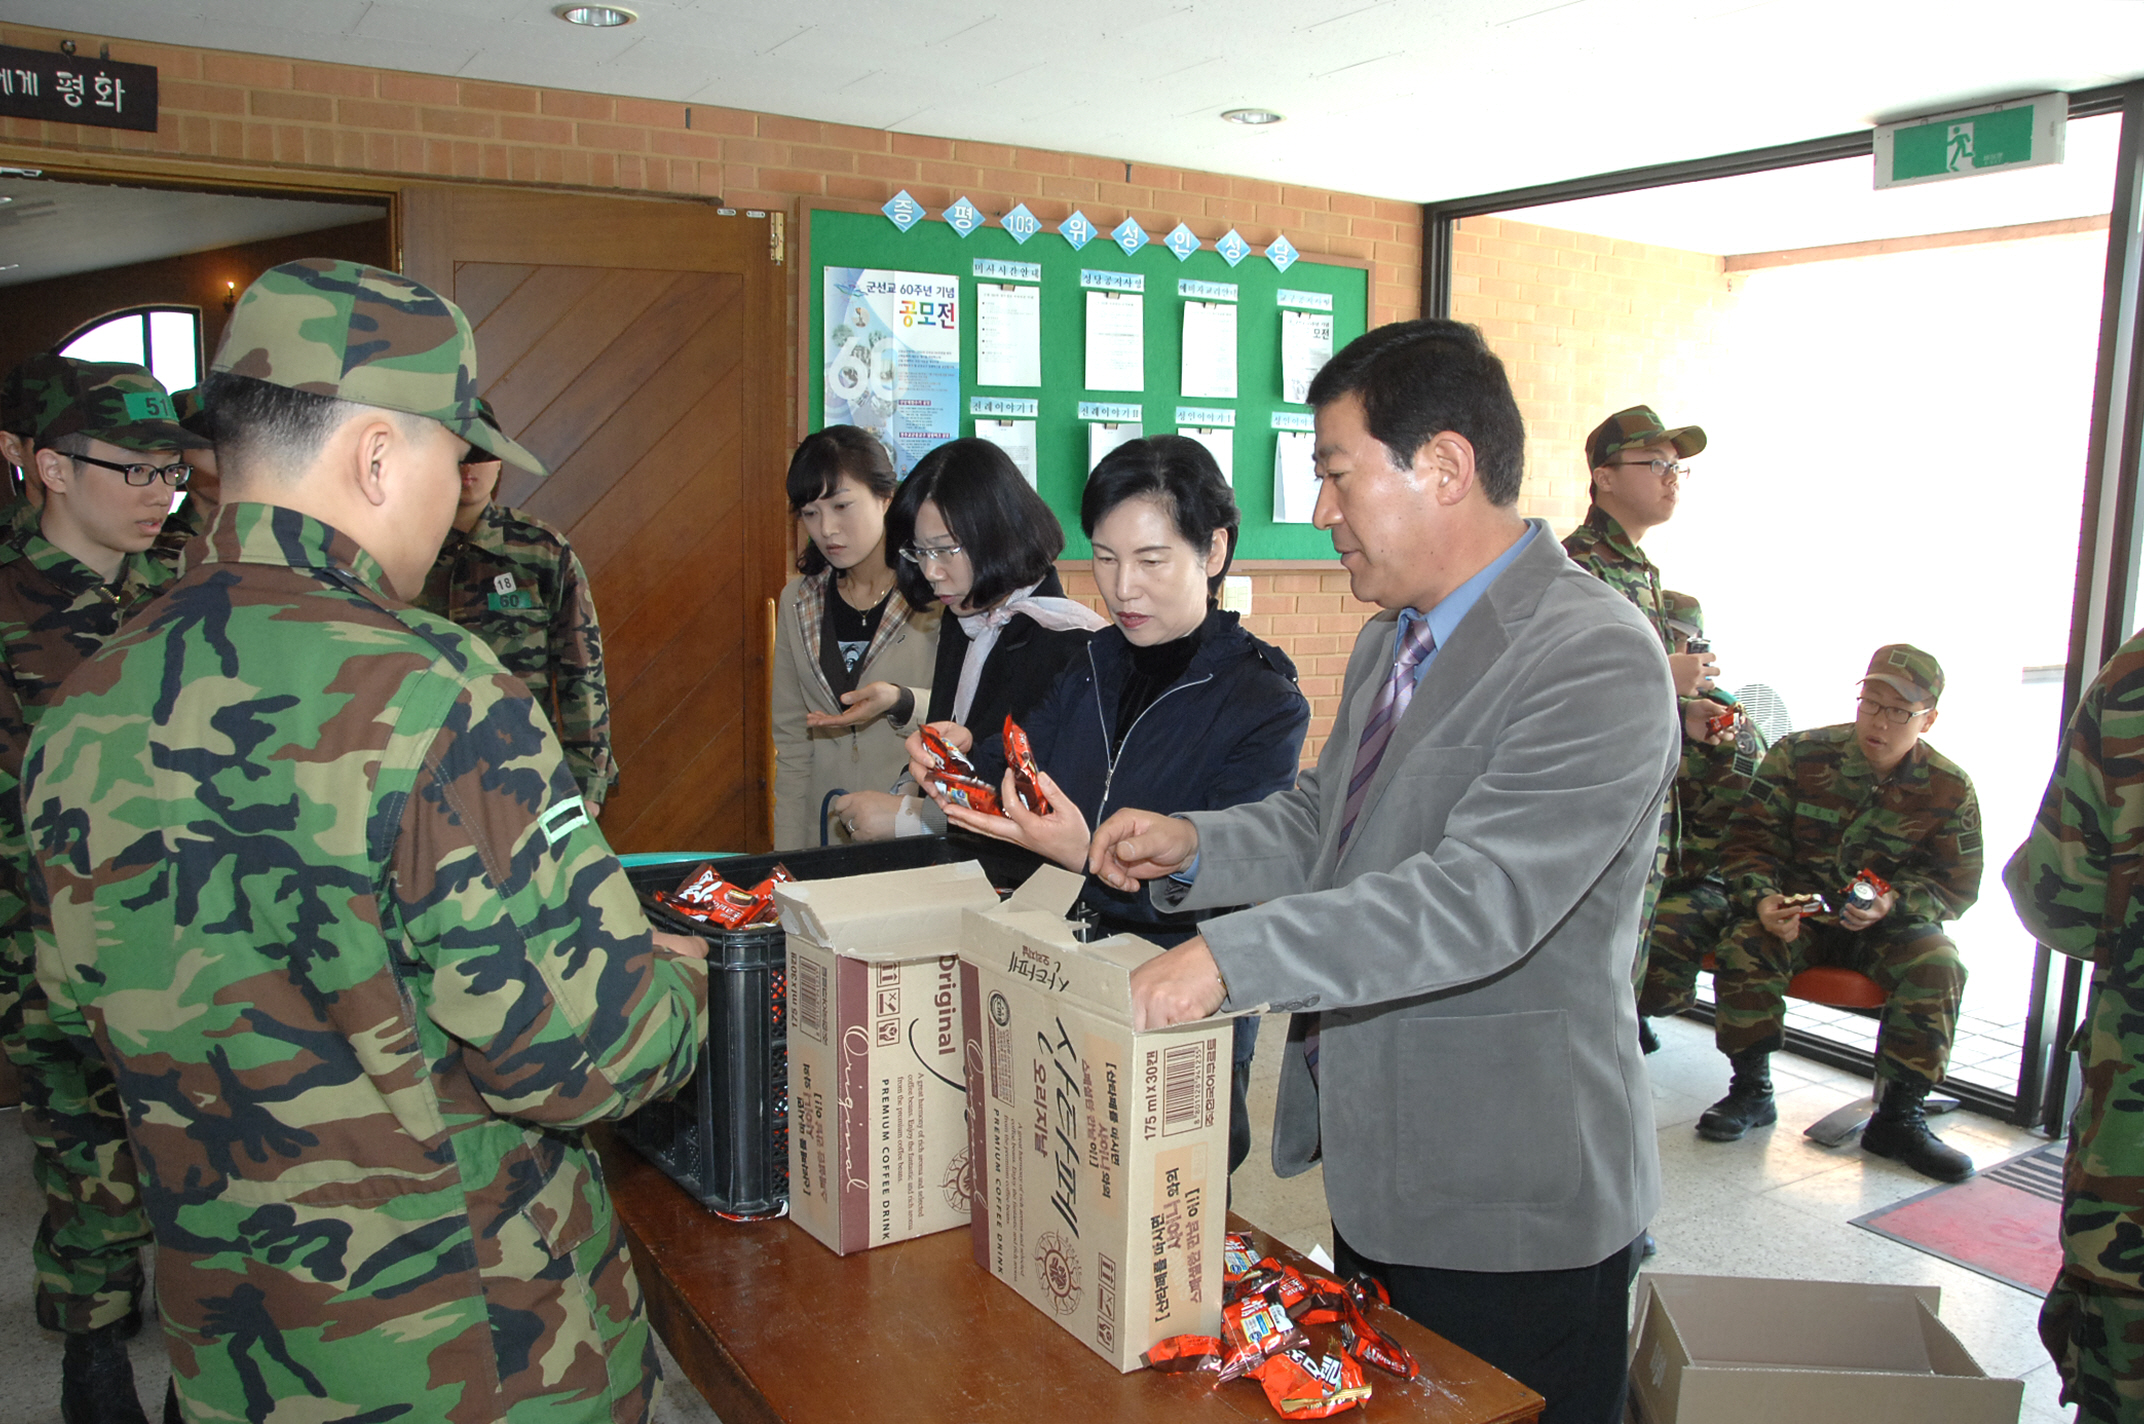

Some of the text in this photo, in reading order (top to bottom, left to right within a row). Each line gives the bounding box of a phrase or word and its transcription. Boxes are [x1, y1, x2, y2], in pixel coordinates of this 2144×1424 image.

[56, 71, 126, 113] 평화
[1008, 214, 1035, 234] 103
[866, 280, 955, 299] 군선교 60주년 기념
[899, 299, 956, 330] 공모전
[145, 397, 170, 417] 51
[497, 577, 512, 591] 18
[499, 594, 519, 608] 60
[1007, 950, 1070, 992] 산타페
[934, 955, 957, 1056] Original
[837, 1025, 870, 1194] Original
[1033, 1058, 1049, 1158] 오리지날
[1037, 1015, 1082, 1240] 산타페
[1144, 1115, 1157, 1141] 175
[881, 1078, 891, 1241] PREMIUM COFFEE DRINK
[993, 1108, 1001, 1172] PREMIUM
[994, 1178, 1002, 1226] COFFEE
[1150, 1213, 1167, 1257] 마시면
[1163, 1199, 1184, 1249] 샤이니
[995, 1232, 1003, 1275] DRINK
